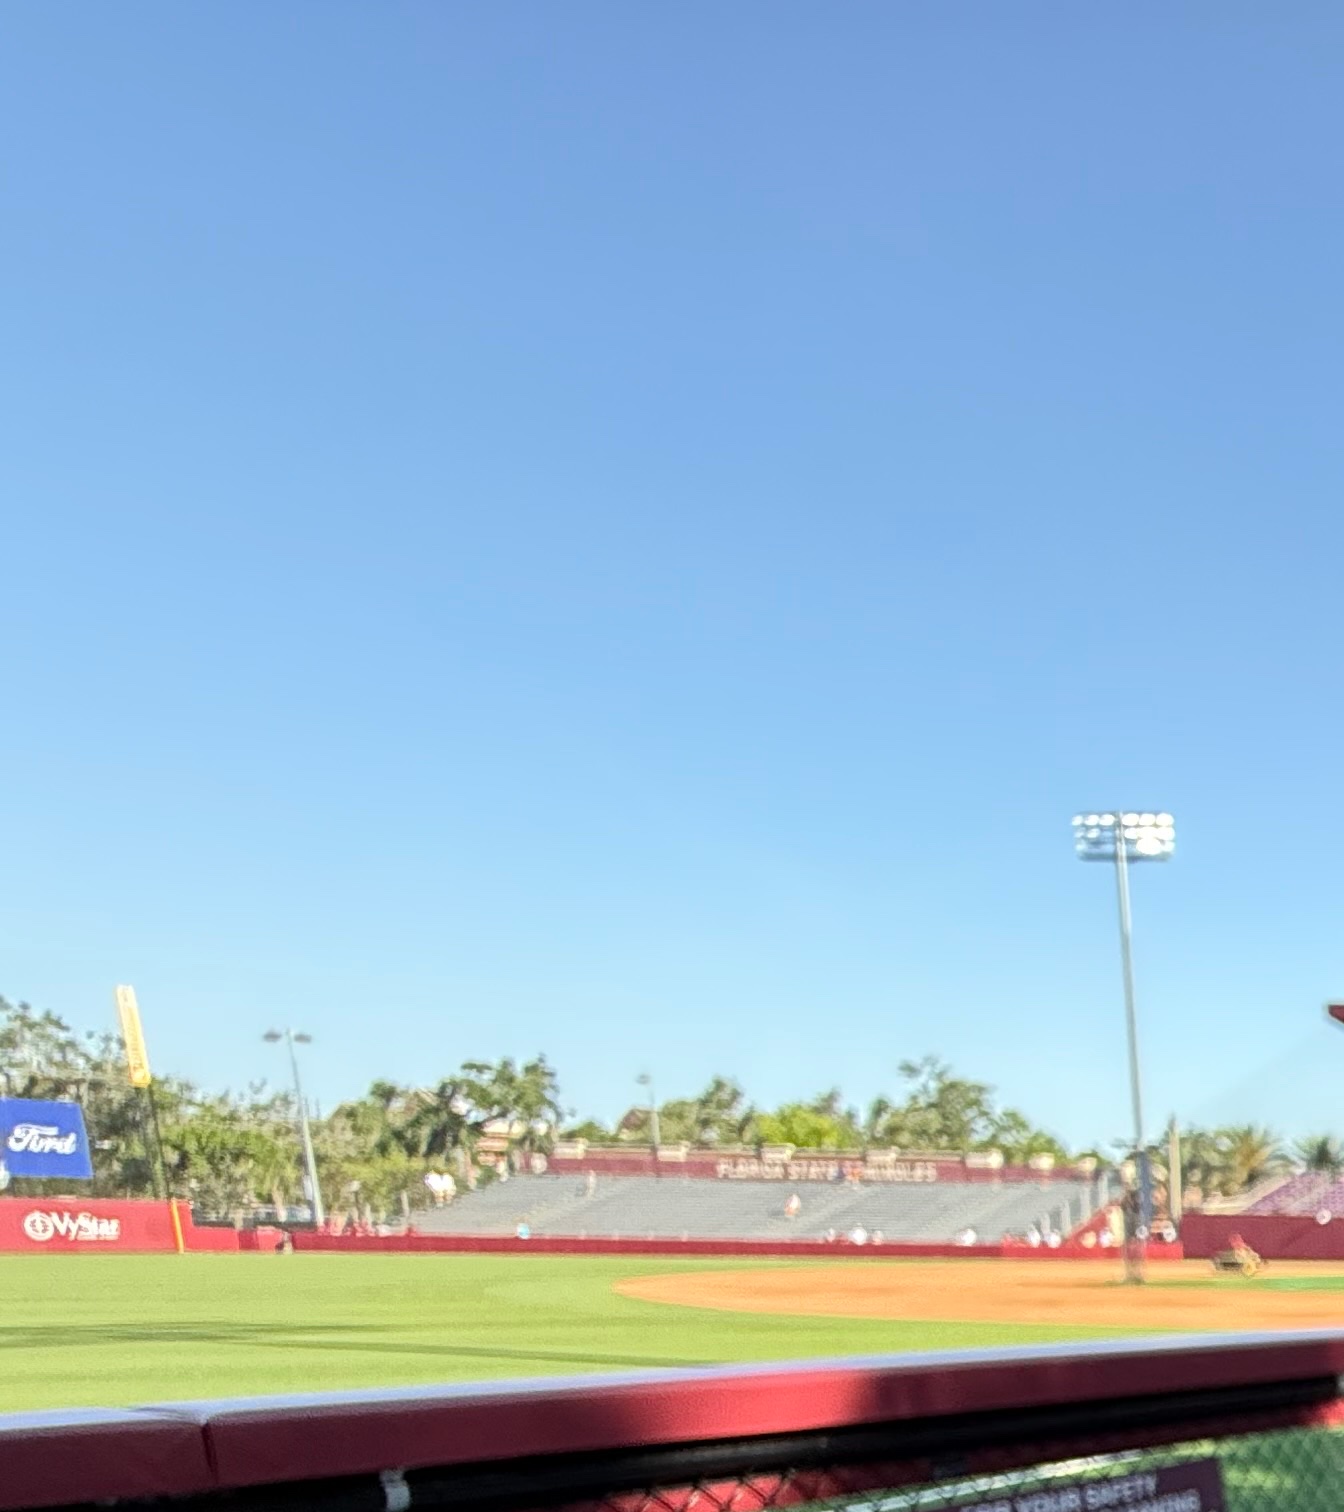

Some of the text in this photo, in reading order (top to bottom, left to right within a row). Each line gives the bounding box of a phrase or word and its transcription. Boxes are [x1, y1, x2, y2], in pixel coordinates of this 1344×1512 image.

[8, 1123, 77, 1155] Ford
[51, 1211, 121, 1241] VyStar
[1085, 1473, 1158, 1508] SAFETY
